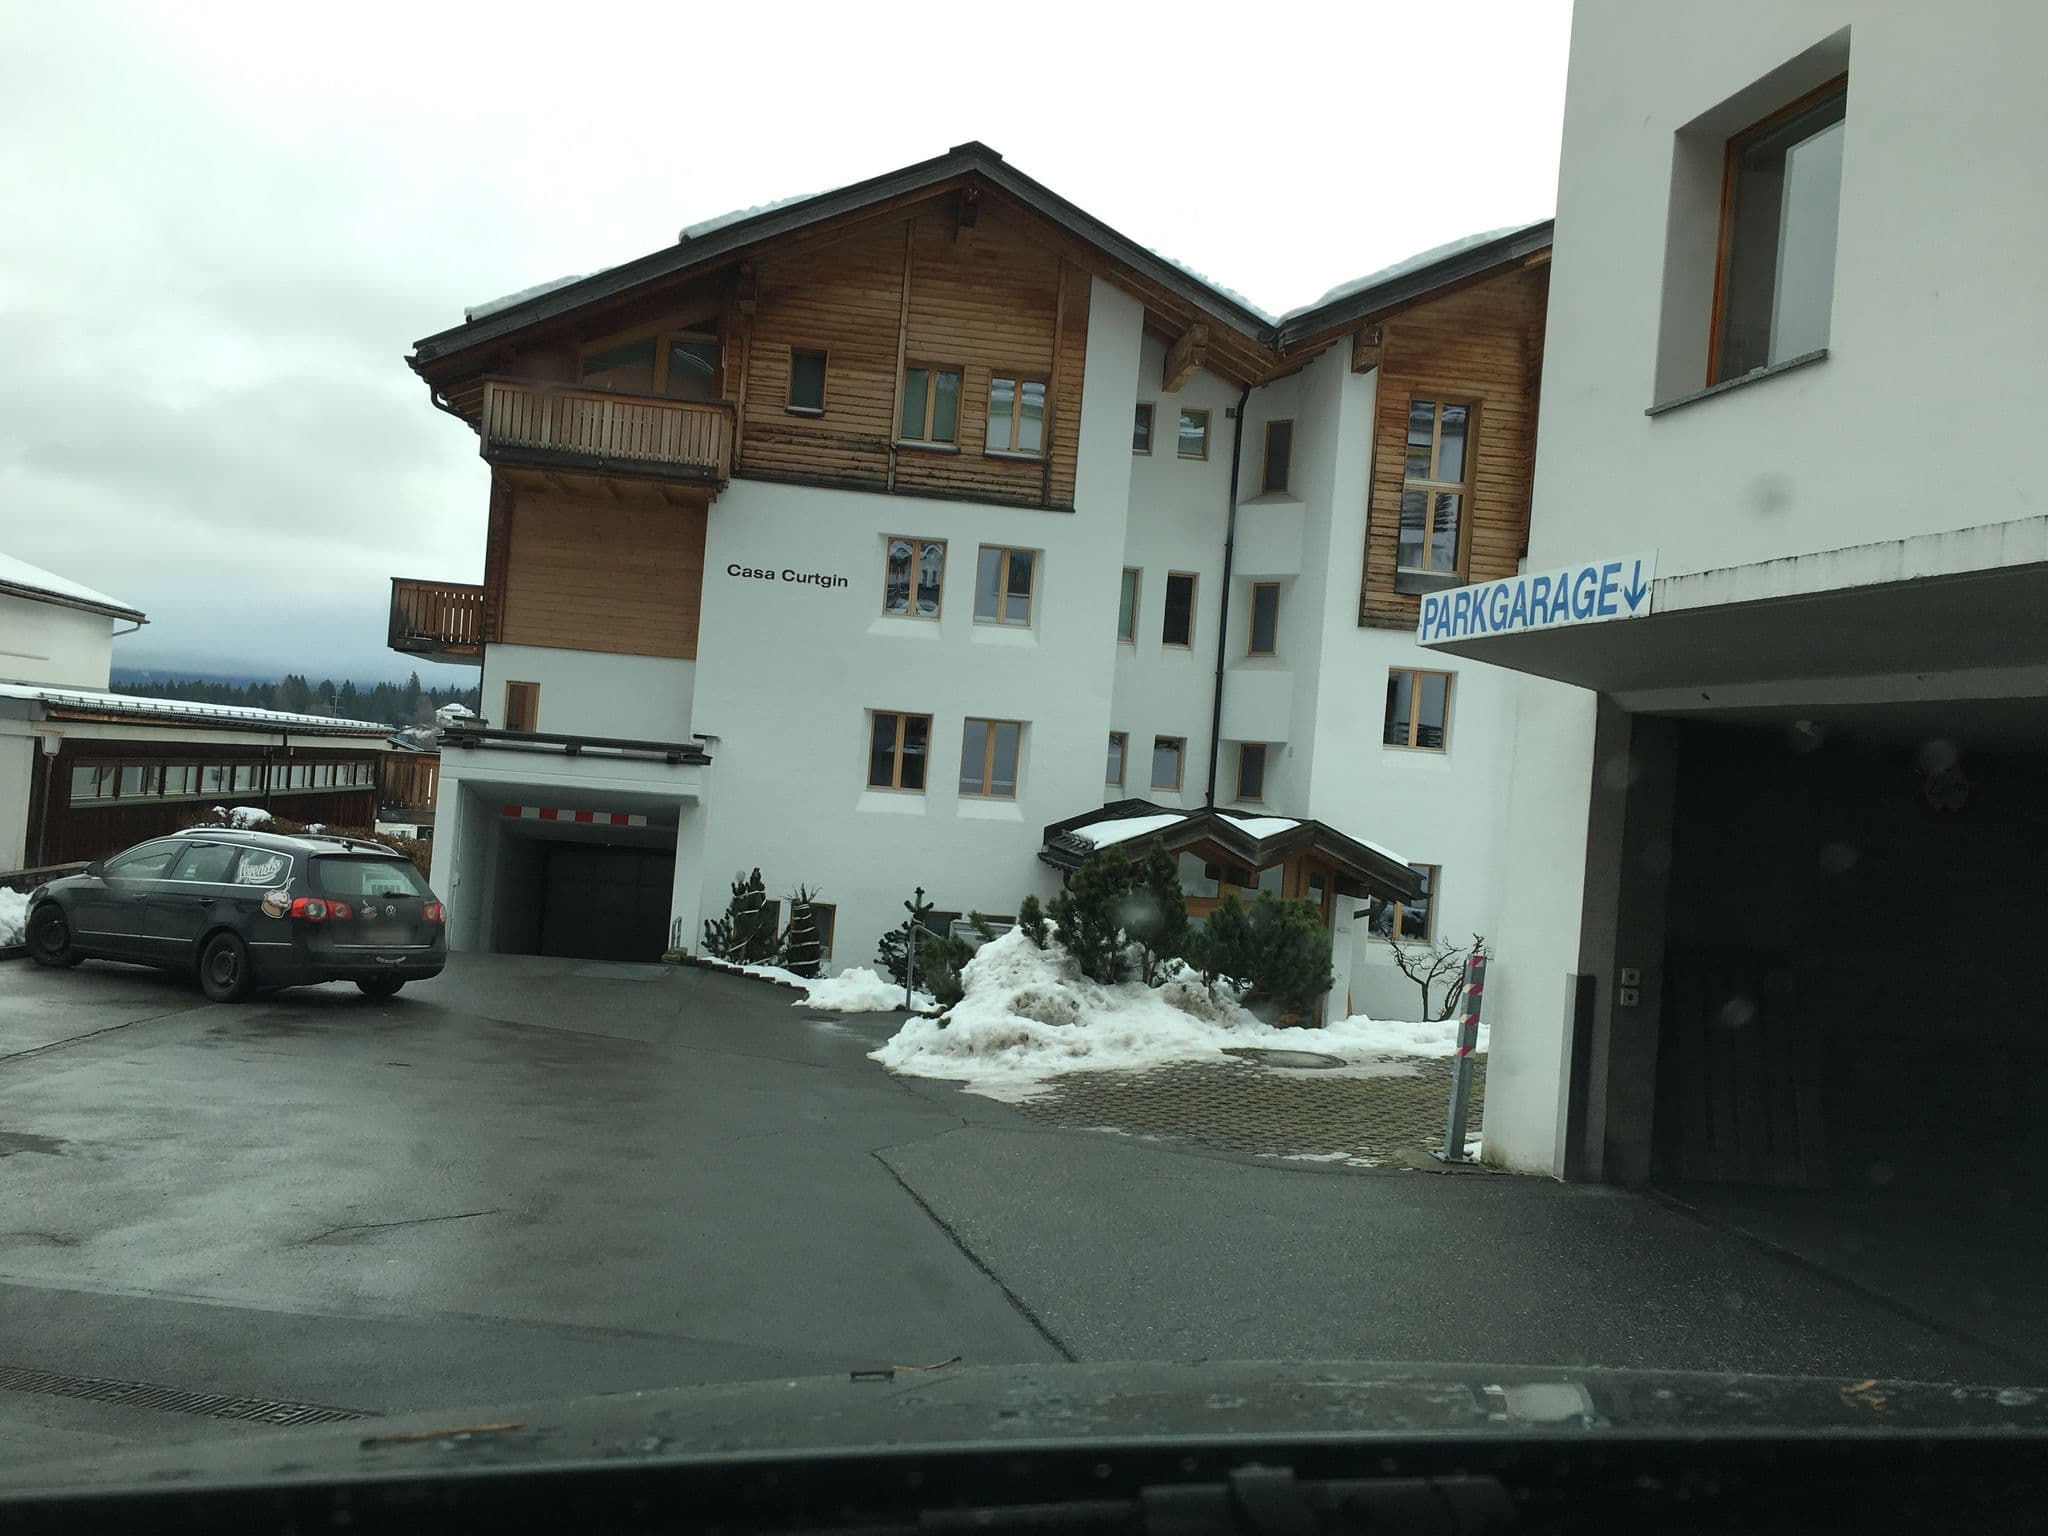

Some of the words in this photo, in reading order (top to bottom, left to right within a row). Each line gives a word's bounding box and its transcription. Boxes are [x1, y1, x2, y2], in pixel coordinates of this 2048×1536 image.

[727, 563, 775, 581] Casa
[781, 569, 848, 588] Curtgin
[1421, 562, 1622, 641] PARKGARAGE
